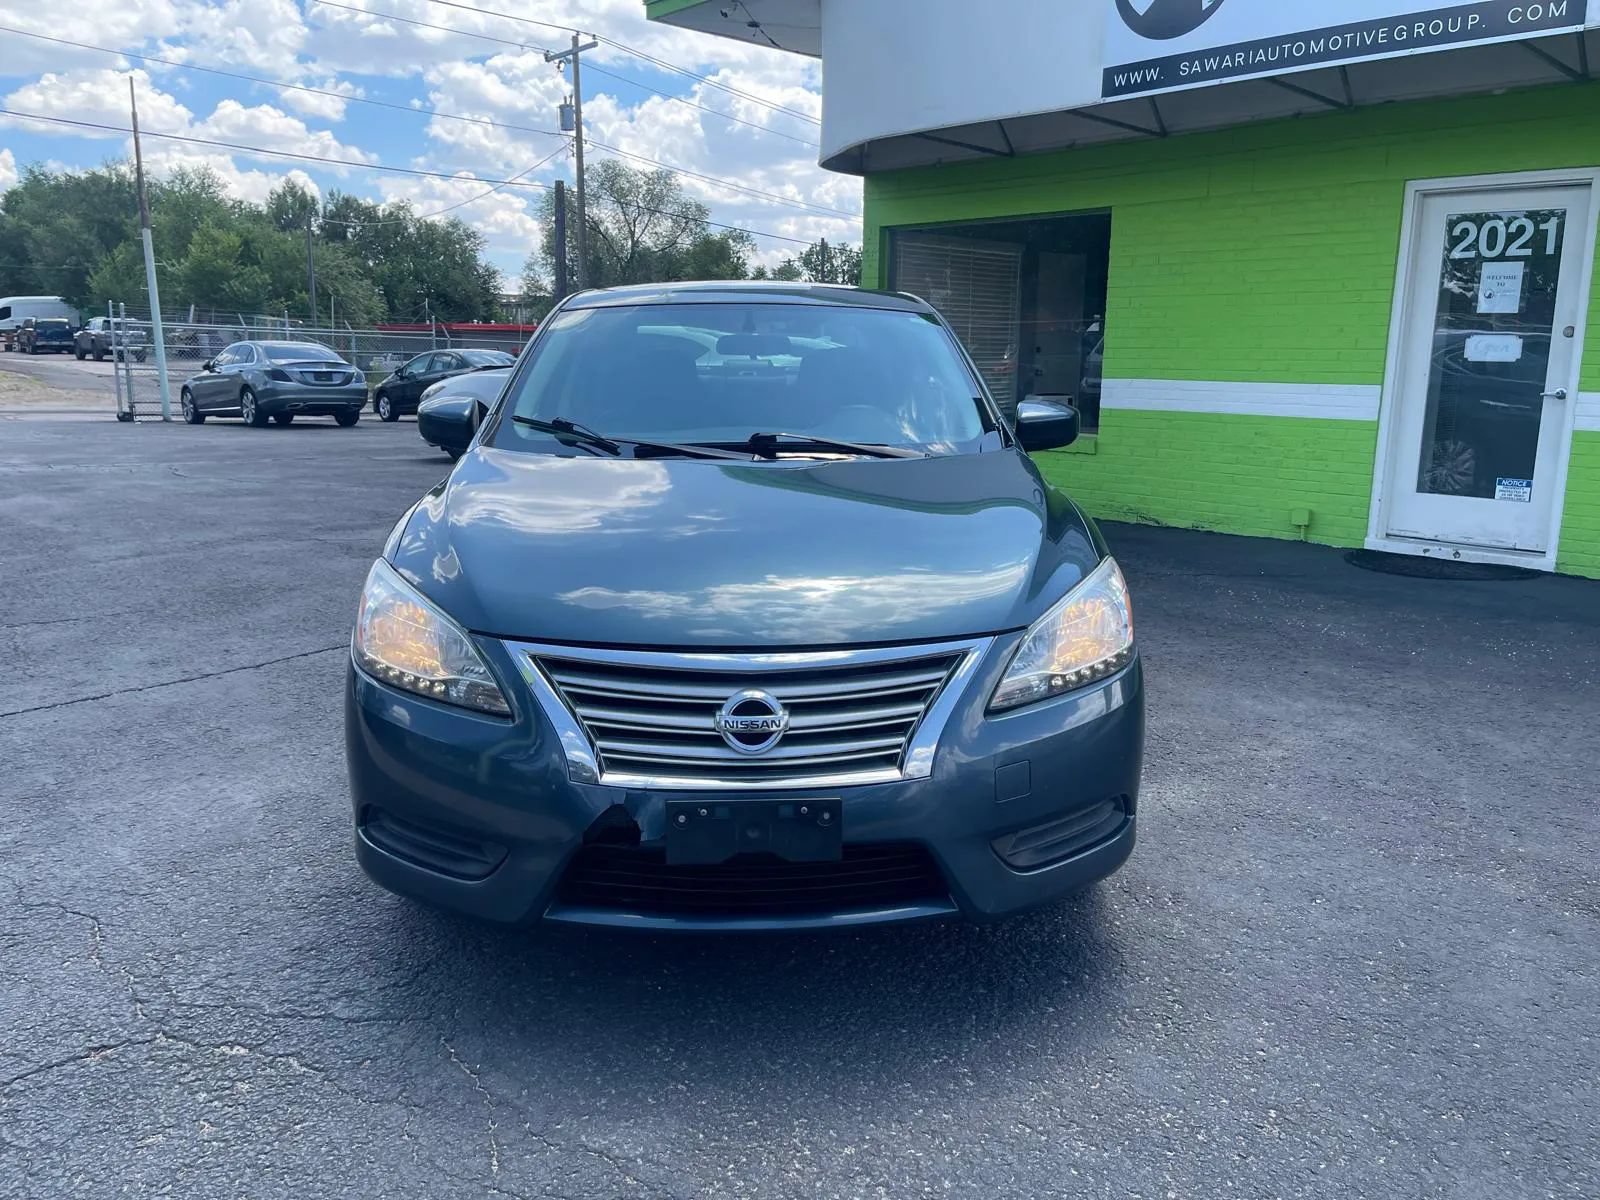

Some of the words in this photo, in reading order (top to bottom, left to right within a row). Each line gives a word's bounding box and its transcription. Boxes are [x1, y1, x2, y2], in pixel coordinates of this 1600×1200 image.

[1114, 67, 1165, 88] WWW.
[1179, 14, 1487, 76] SAWARIAUTOMOTIVEGROUP.
[1507, 0, 1568, 24] COM
[1450, 217, 1558, 259] 2021
[724, 719, 781, 729] NISSAN
